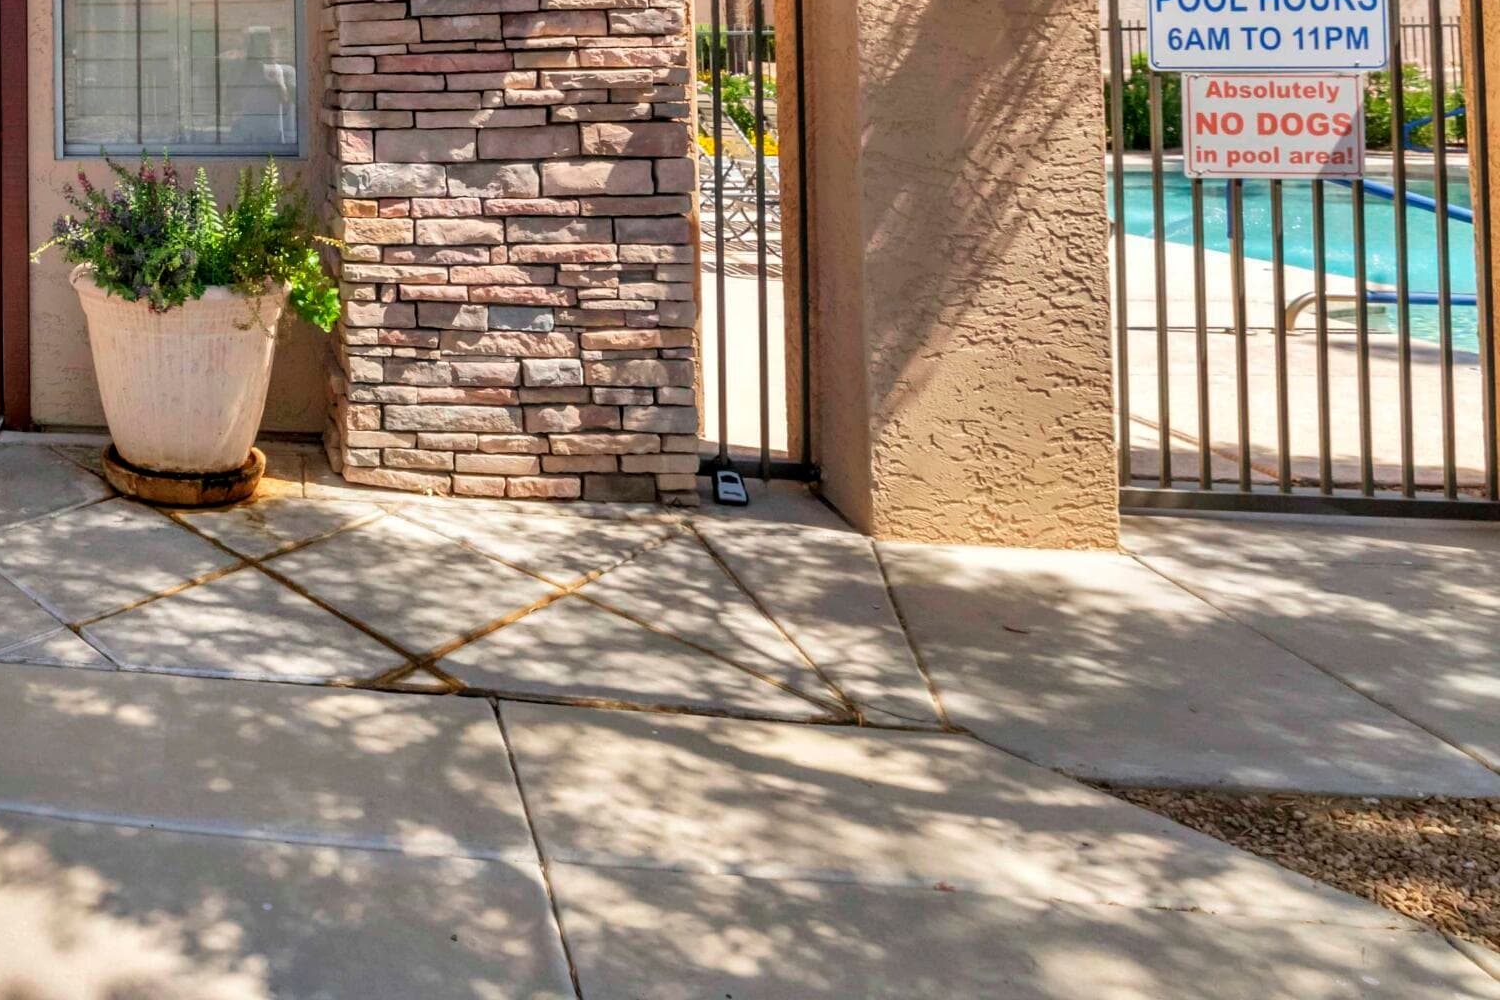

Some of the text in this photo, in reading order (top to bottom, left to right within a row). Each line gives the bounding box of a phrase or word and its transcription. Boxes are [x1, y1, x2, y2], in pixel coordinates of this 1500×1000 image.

[1167, 26, 1370, 51] 6AM TO 11PM
[1205, 80, 1340, 103] Absolutely
[1195, 112, 1352, 137] NO DOGS
[1195, 146, 1354, 168] in pool area!
